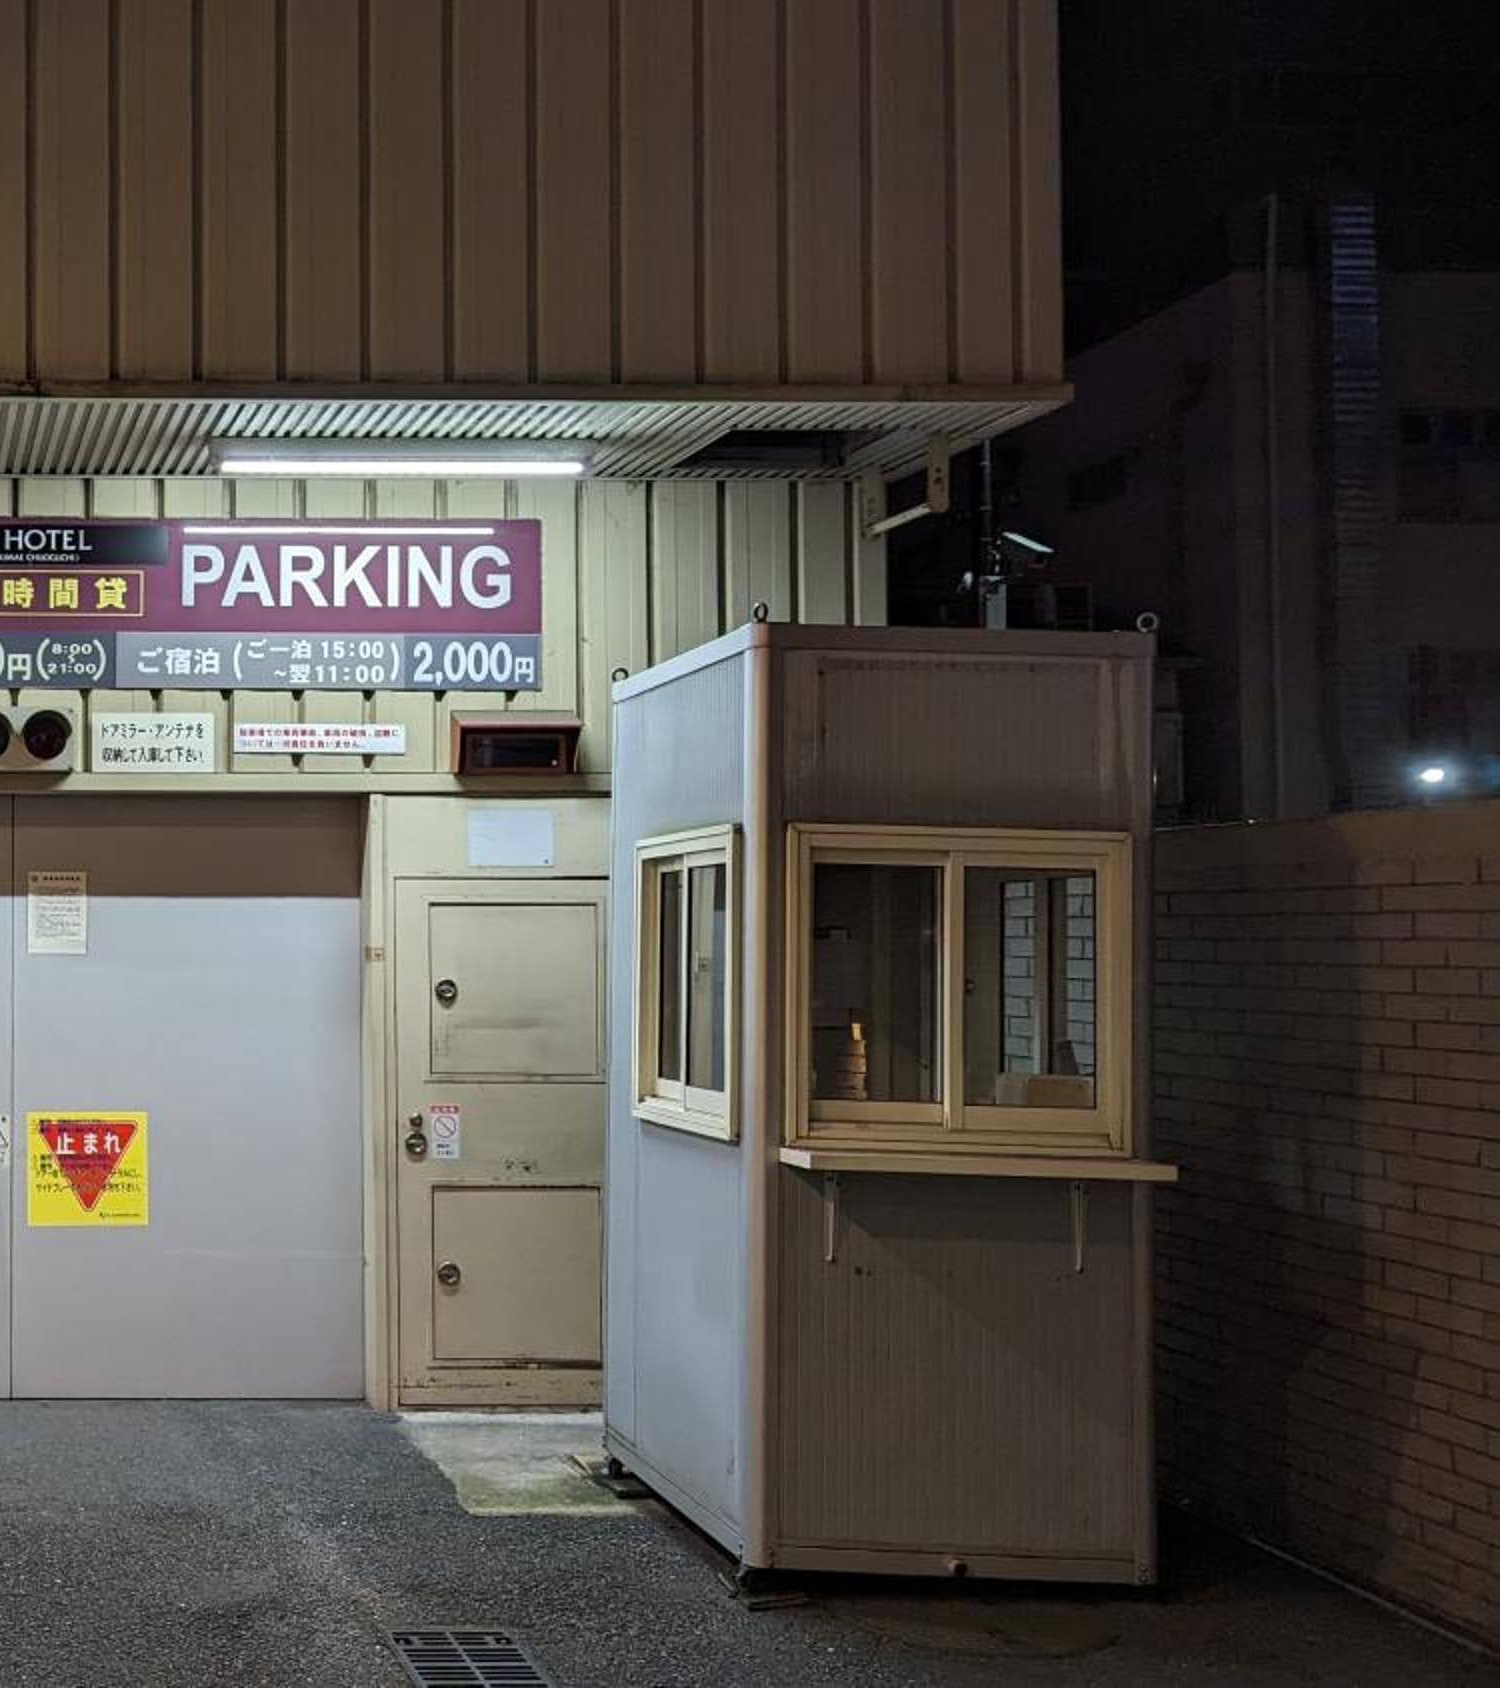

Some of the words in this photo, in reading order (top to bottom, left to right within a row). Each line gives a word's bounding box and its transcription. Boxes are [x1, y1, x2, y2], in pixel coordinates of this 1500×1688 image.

[4, 529, 92, 550] HOTEL
[181, 544, 512, 609] PARKING
[137, 647, 220, 676] ご宿泊
[321, 641, 384, 660] 15:00
[412, 640, 535, 686] 2,000円
[55, 1132, 122, 1155] 止まれ
